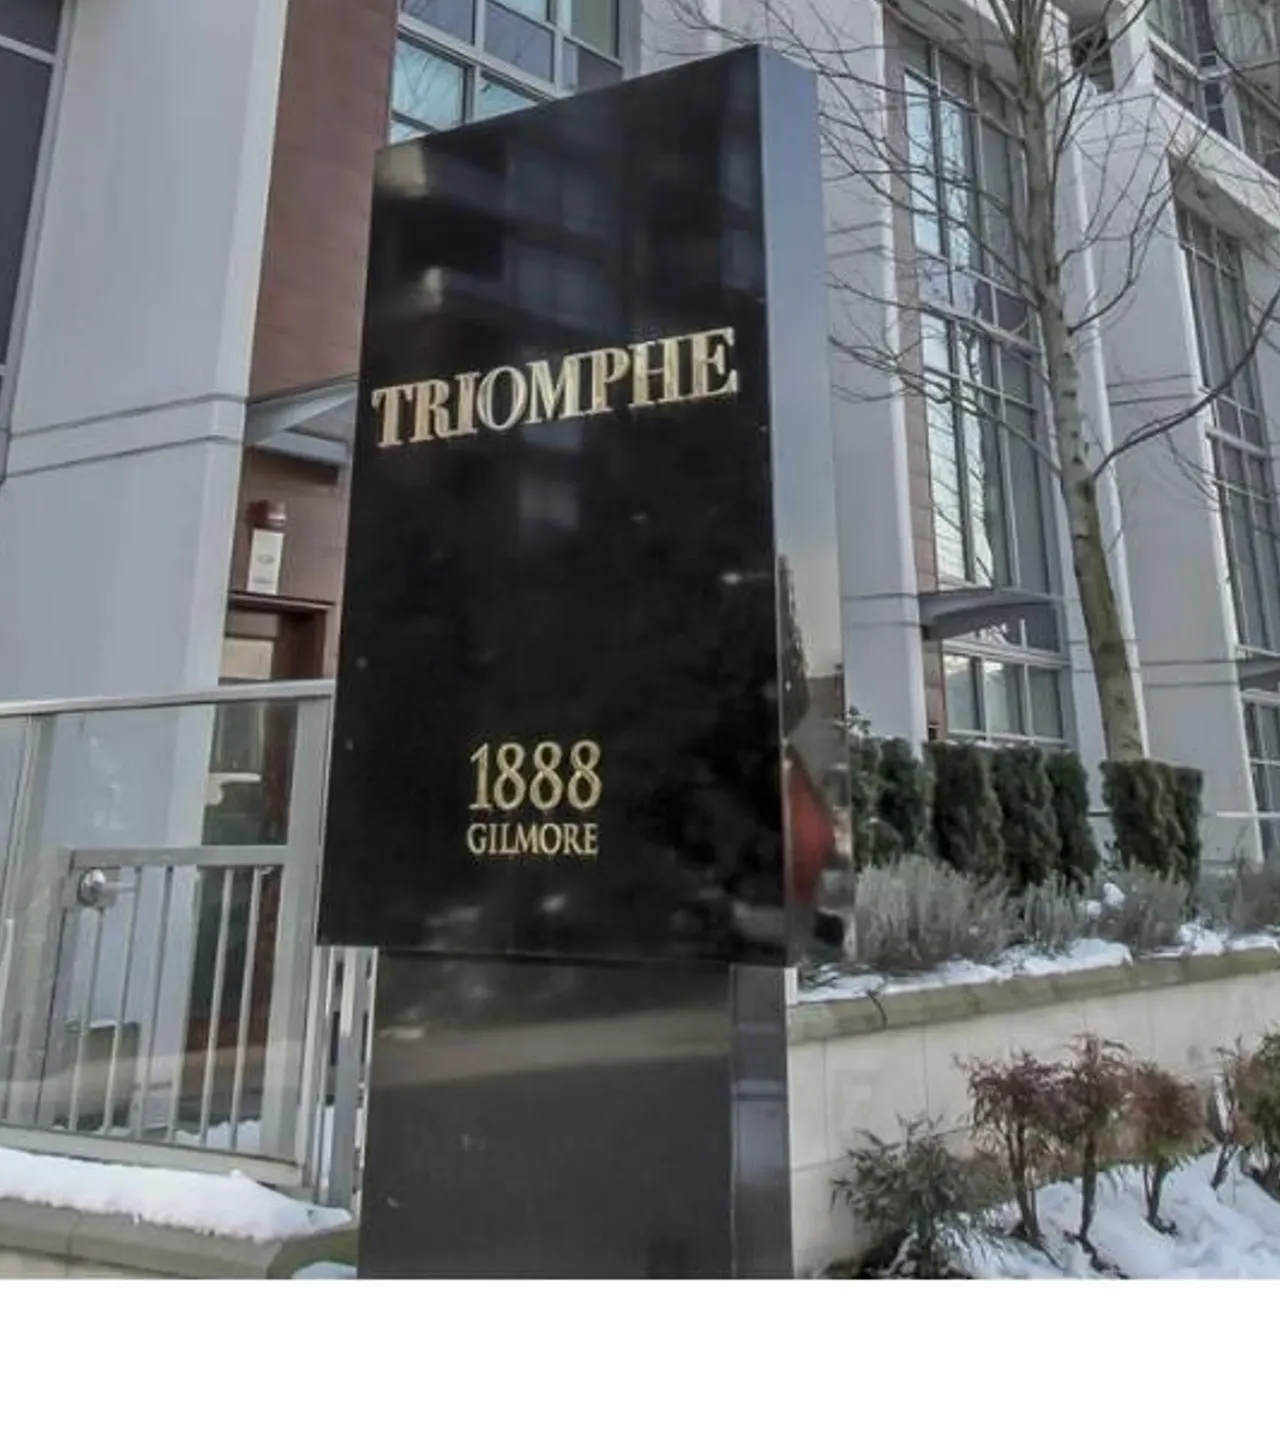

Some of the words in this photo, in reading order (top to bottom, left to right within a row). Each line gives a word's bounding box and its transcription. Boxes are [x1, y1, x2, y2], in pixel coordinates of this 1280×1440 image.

[371, 326, 739, 448] TRIOMPHE
[468, 740, 601, 811] 1888
[466, 821, 598, 855] GILMORE
